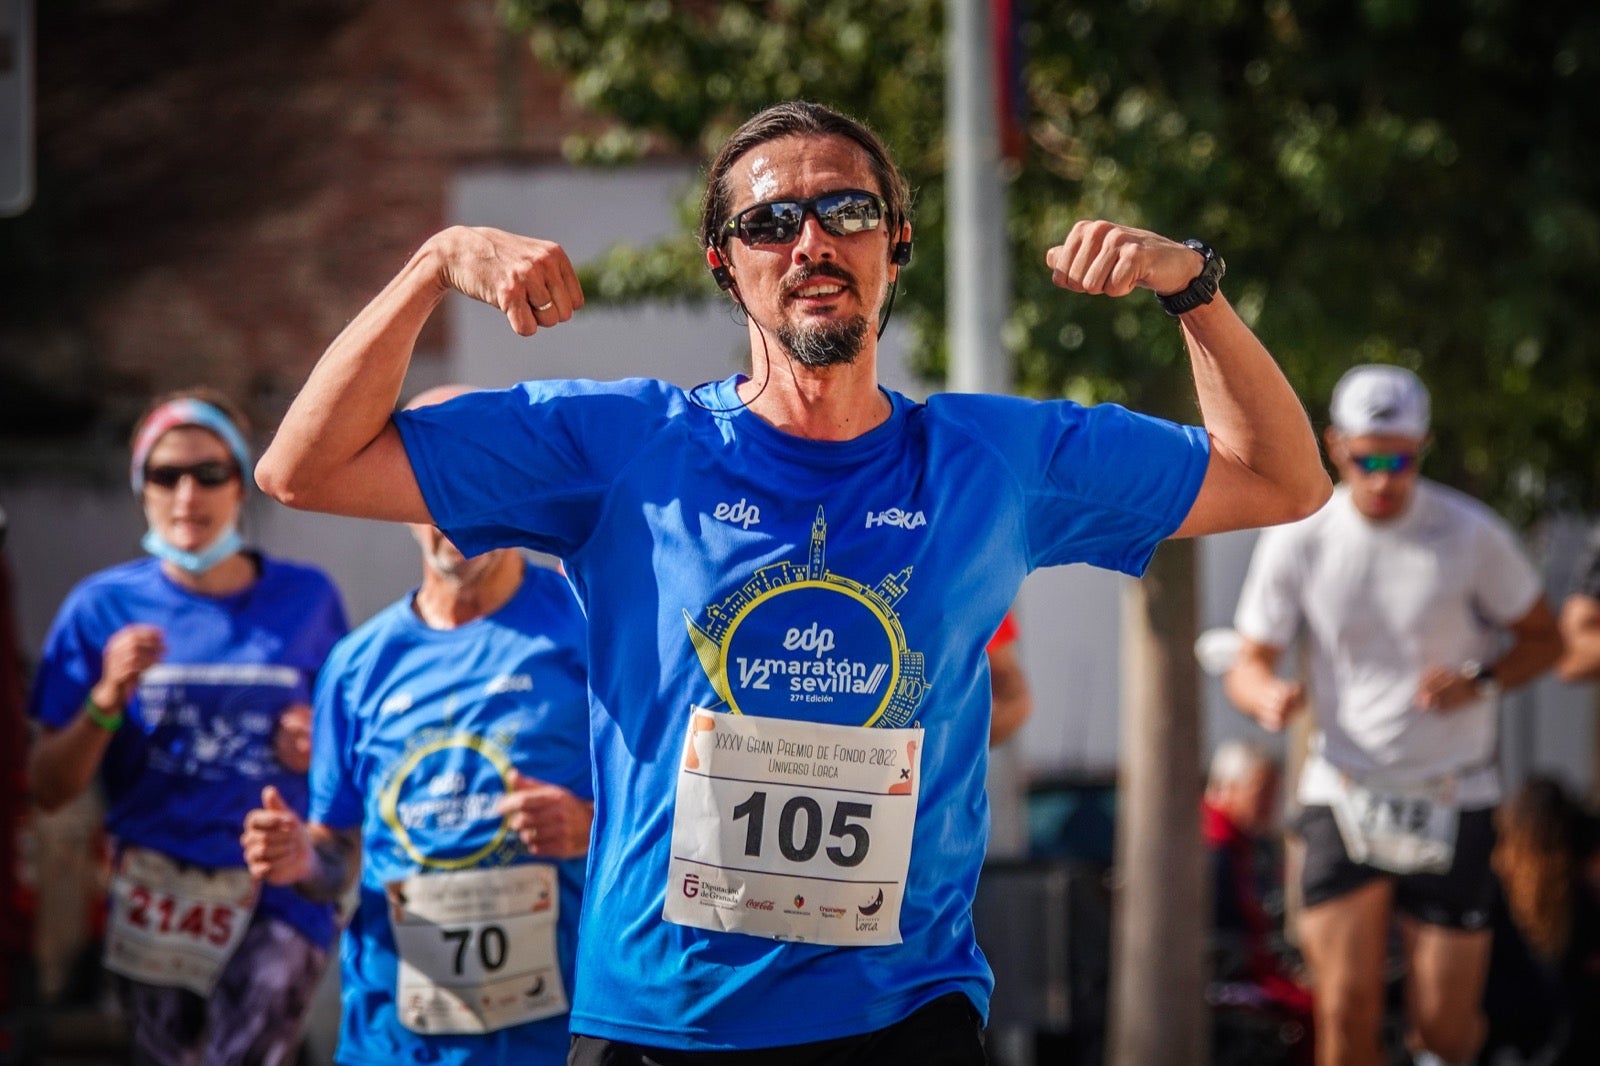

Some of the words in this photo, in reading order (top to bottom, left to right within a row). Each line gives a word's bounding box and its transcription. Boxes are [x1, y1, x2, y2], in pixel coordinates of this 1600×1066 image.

[713, 498, 760, 530] edp
[865, 507, 927, 530] HOKA
[783, 622, 836, 659] edp
[765, 657, 866, 677] maratón
[789, 674, 864, 694] sevilla
[805, 694, 834, 703] Edición
[715, 732, 744, 752] XXXV
[869, 748, 898, 767] 2022
[732, 791, 873, 868] 105
[127, 884, 235, 947] 2145
[441, 923, 510, 976] 70
